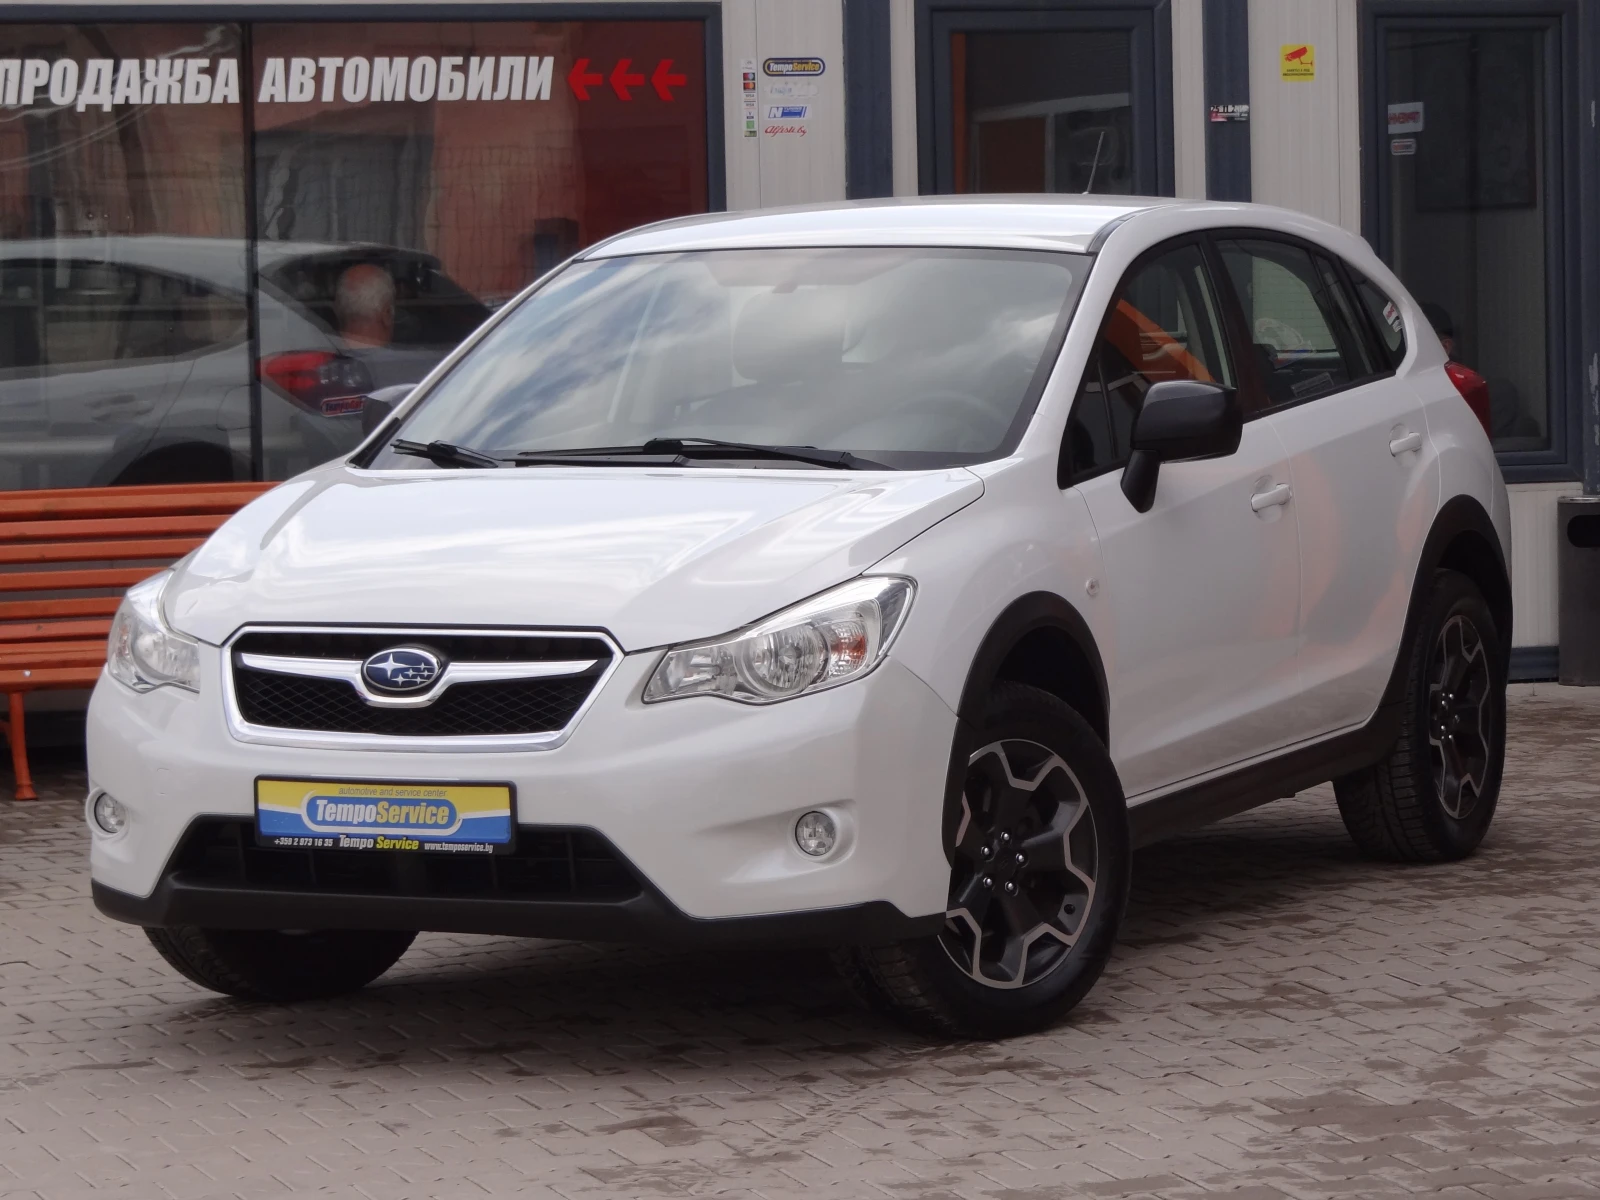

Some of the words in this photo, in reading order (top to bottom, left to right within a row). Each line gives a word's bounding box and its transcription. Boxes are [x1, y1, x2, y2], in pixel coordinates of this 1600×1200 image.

[769, 61, 820, 74] TempoService
[0, 58, 240, 112] ПРОДАЖБА
[257, 56, 555, 103] АВТОМОБИЛИ
[338, 787, 378, 796] automotive
[379, 788, 393, 796] and
[395, 788, 422, 797] service
[423, 789, 448, 797] center
[316, 799, 450, 824] TempoService
[274, 837, 293, 845] +359
[293, 837, 299, 845] 2
[299, 838, 313, 846] 973
[314, 839, 323, 847] 16
[323, 839, 334, 847] 35
[338, 834, 375, 849] Tempo
[375, 835, 419, 850] Service
[424, 842, 494, 853] www.temposervice.bg
